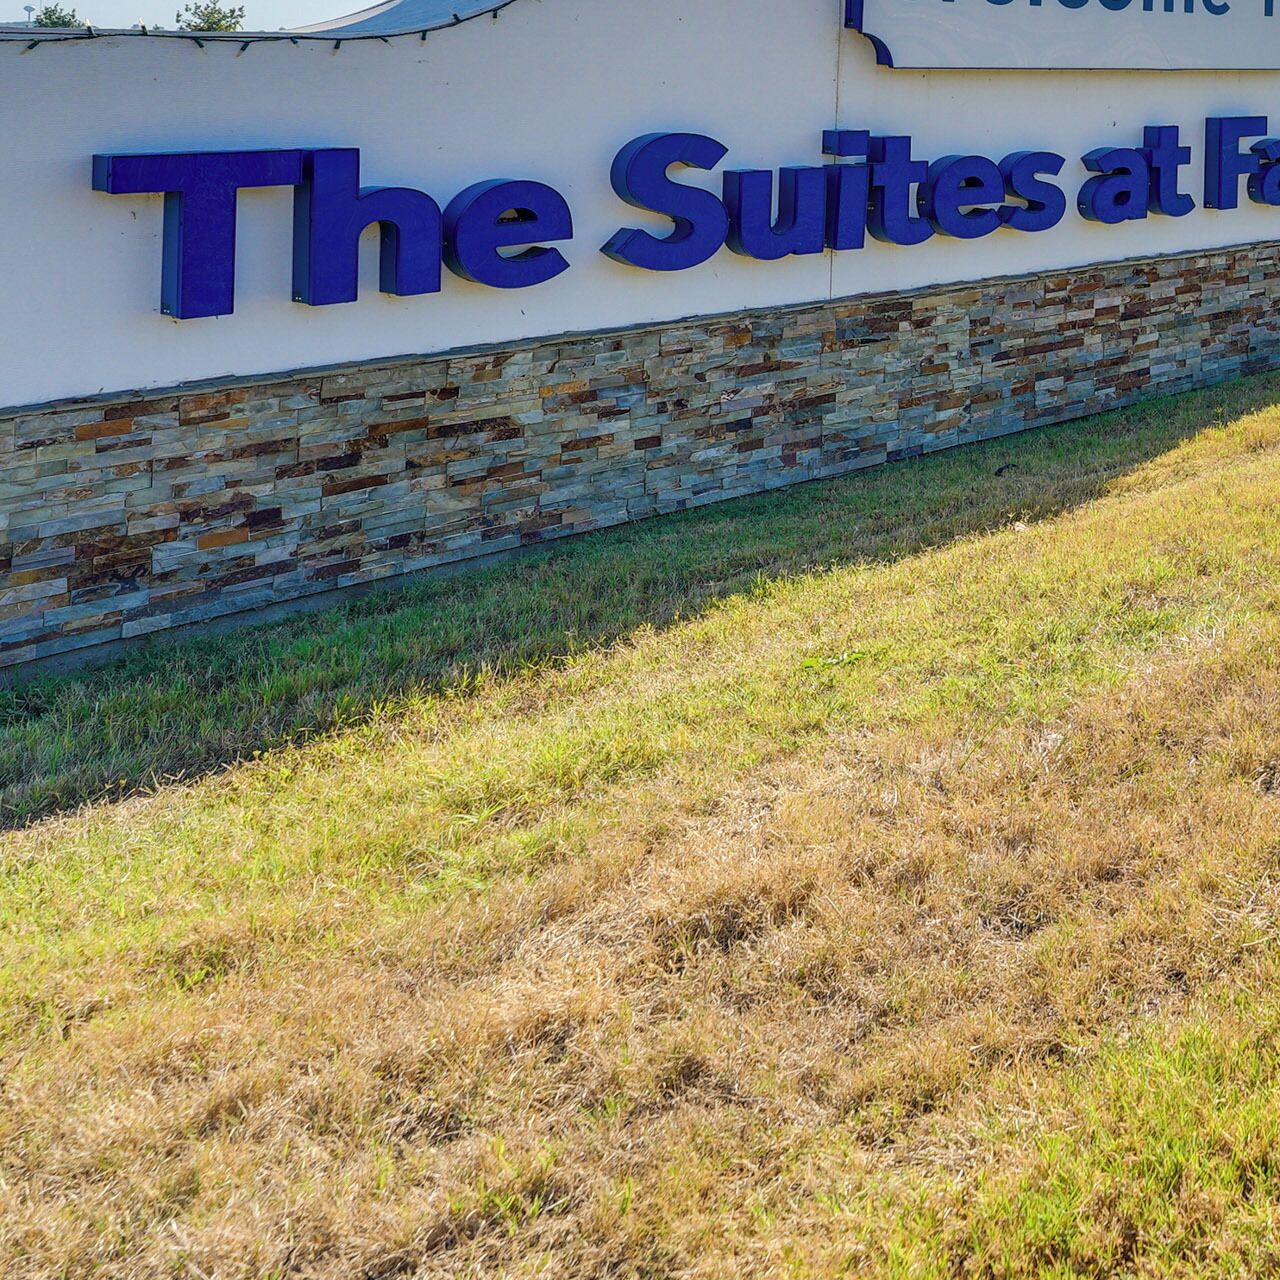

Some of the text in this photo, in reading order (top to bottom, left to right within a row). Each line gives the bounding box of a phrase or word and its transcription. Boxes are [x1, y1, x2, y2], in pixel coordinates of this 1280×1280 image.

[90, 146, 574, 320] The
[598, 129, 1067, 272] Suites
[1076, 124, 1196, 225] at
